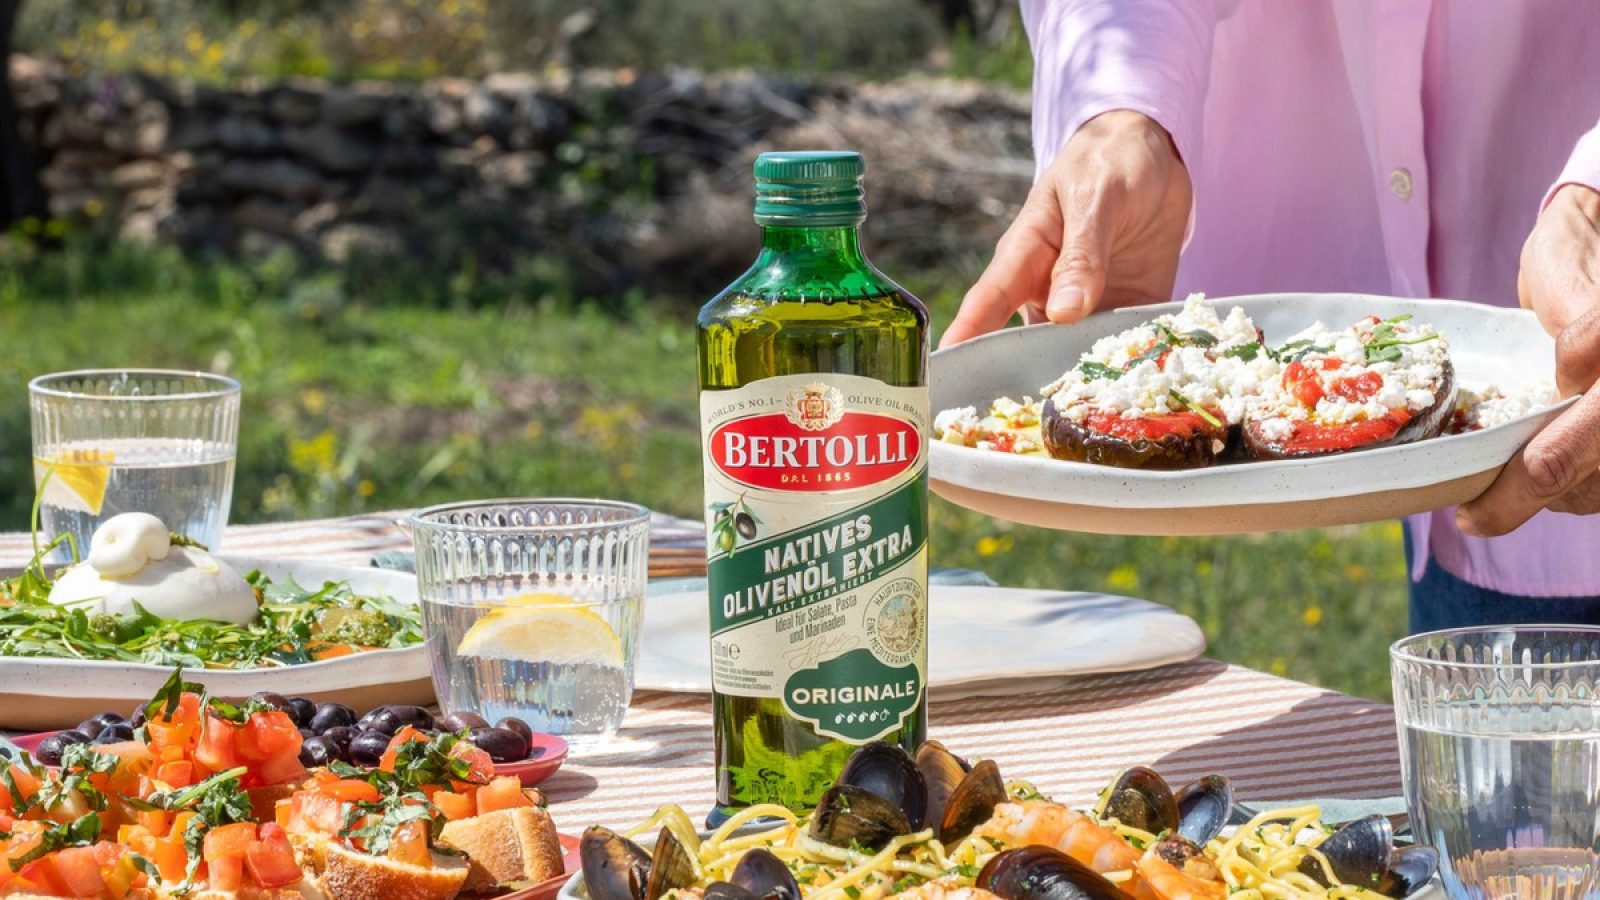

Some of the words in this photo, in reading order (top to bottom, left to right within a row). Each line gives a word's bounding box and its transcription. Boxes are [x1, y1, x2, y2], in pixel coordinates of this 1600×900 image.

[848, 395, 882, 407] OLIVE
[885, 399, 901, 410] OIL
[723, 431, 908, 468] BERTOLLI
[781, 475, 809, 484] DAL
[817, 472, 851, 482] 1865
[764, 514, 873, 574] NATIVES
[722, 559, 837, 619] OLIVENÖL
[842, 524, 913, 581] EXTRA
[767, 601, 796, 617] KALT
[801, 572, 873, 606] EXTRAHIERT
[775, 613, 794, 633] Ideal
[795, 610, 806, 627] für
[808, 604, 834, 623] Salate,
[836, 594, 857, 612] Pasta
[789, 626, 805, 645] und
[806, 614, 846, 638] Marinaden
[866, 617, 876, 637] EINE
[791, 679, 916, 705] ORIGINALE
